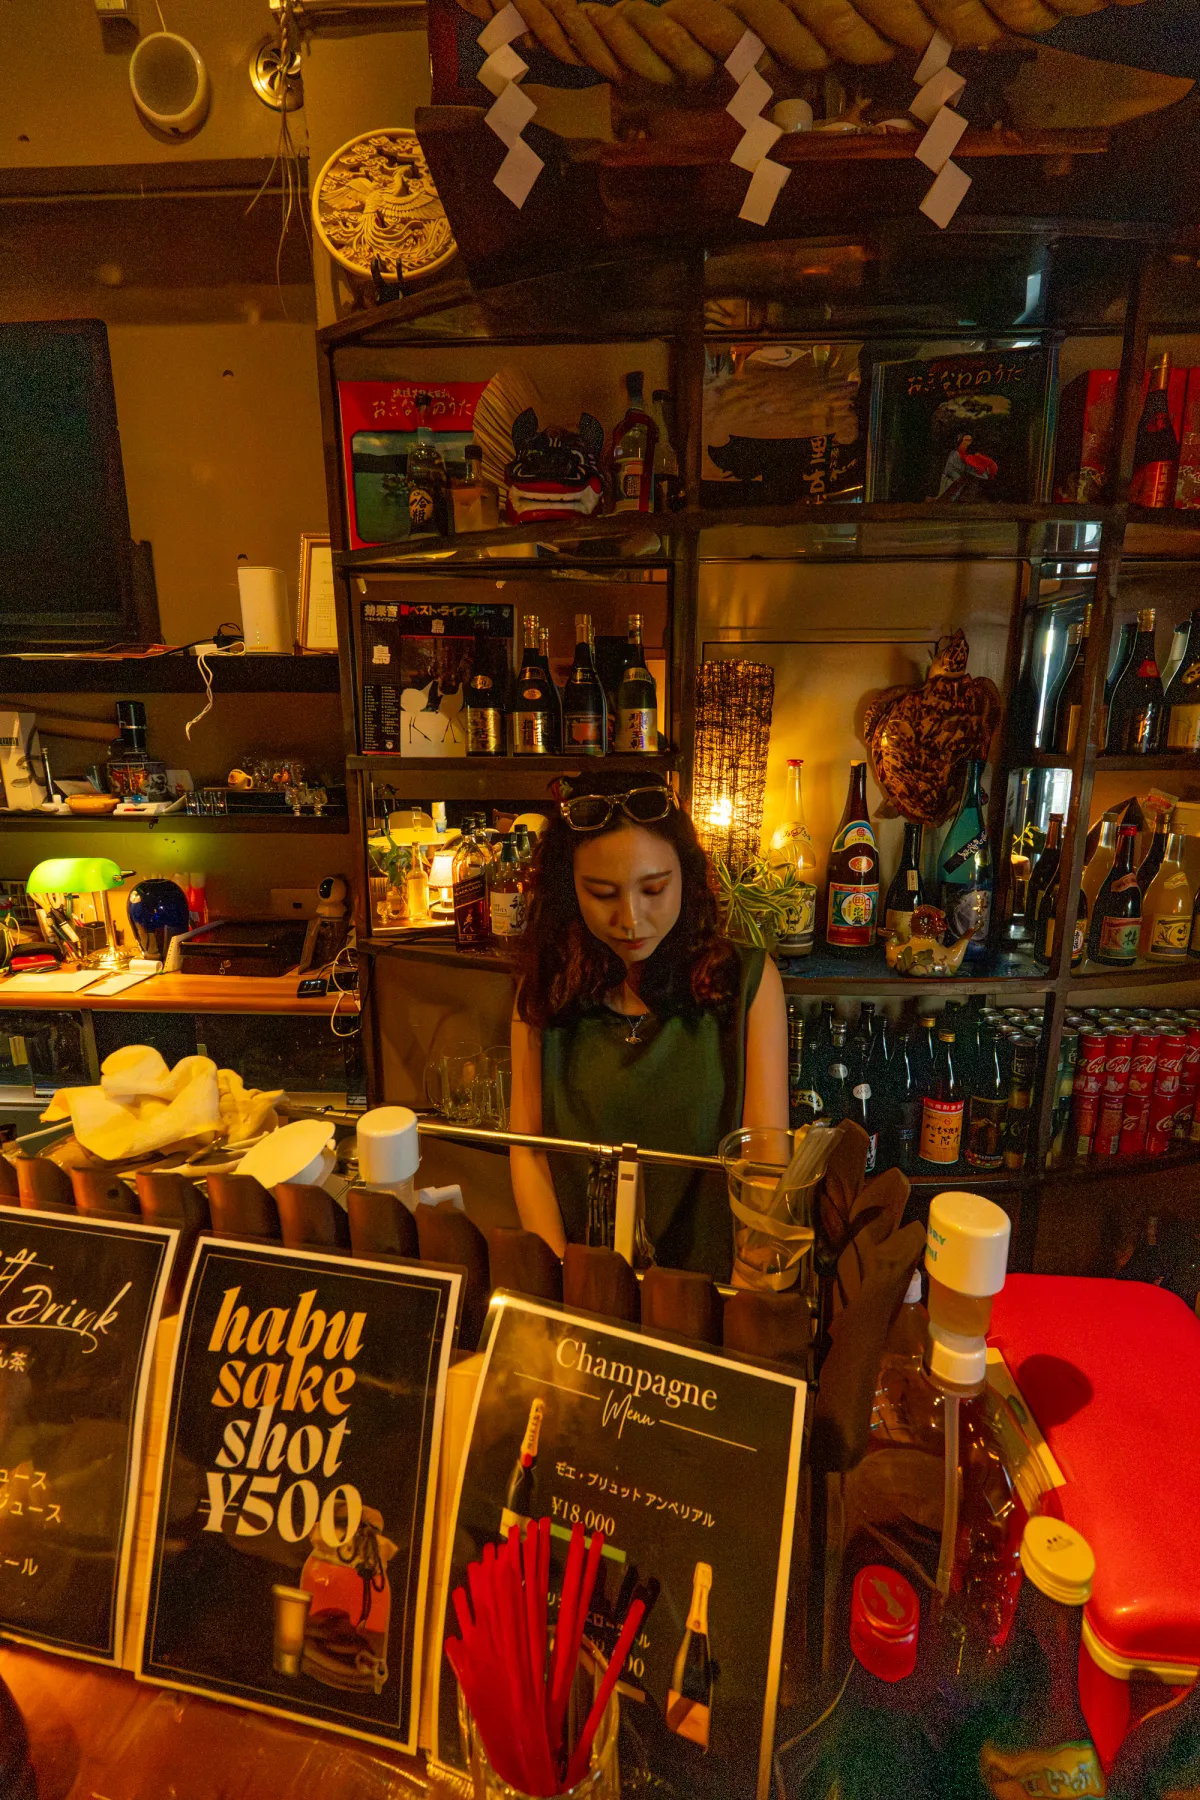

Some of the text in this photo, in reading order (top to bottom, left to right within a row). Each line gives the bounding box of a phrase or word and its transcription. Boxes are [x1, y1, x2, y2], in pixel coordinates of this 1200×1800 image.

[372, 397, 473, 419] おきなのうた
[6, 1281, 133, 1336] Drink
[207, 1285, 368, 1361] habu
[210, 1353, 357, 1416] sake
[556, 1337, 718, 1411] Champagne
[214, 1403, 352, 1478] shot
[601, 1388, 656, 1440] Menu
[197, 1472, 364, 1549] ¥500
